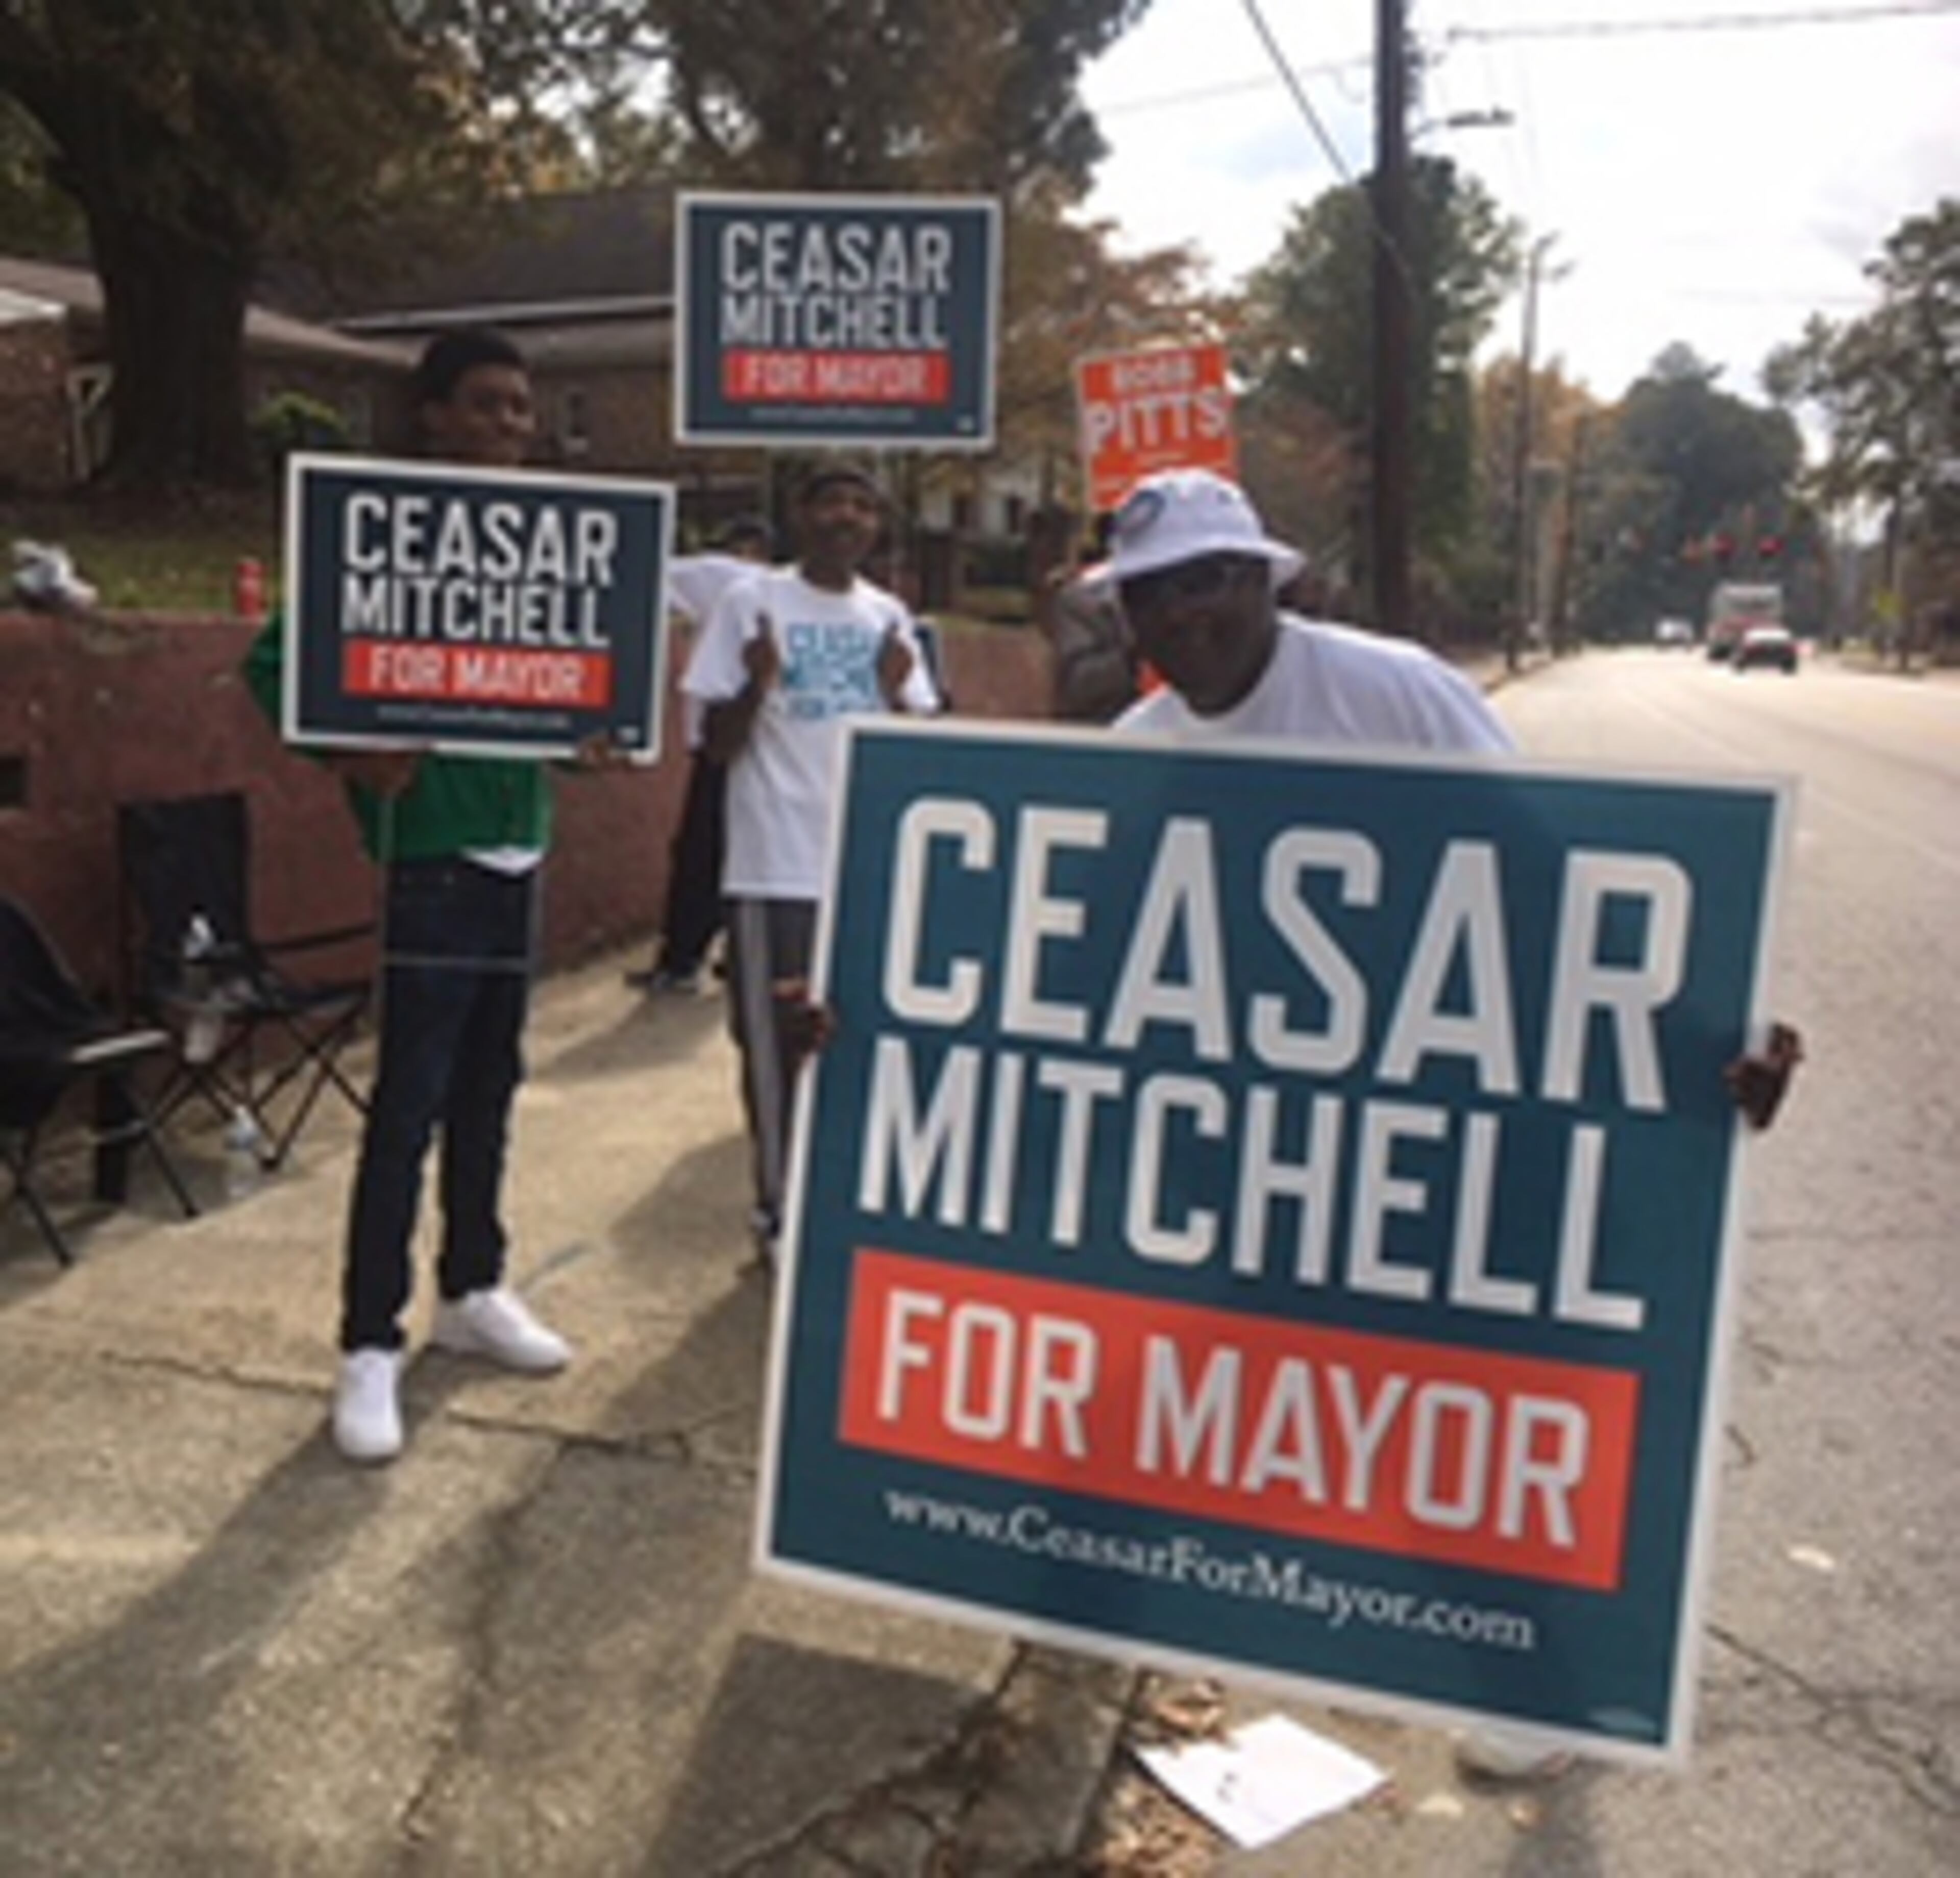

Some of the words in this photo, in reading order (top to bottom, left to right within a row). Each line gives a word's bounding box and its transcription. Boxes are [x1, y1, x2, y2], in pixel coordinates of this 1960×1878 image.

[721, 221, 950, 292] CEASAR
[721, 293, 947, 349] MITCHELL
[746, 355, 805, 397] FOR
[817, 355, 928, 399] MAYOR
[1080, 392, 1229, 453] PITTS
[345, 494, 617, 585] CEASAR
[342, 572, 610, 647] MITCHELL
[370, 646, 444, 690] FOR
[455, 653, 583, 700] MAYOR
[883, 797, 1693, 1111] CEASAR
[857, 1036, 1645, 1330] MITCHELL
[877, 1289, 1099, 1460] FOR
[1135, 1334, 1589, 1551] MAYOR
[885, 1486, 1534, 1651] www.CeasarForMayor.com
